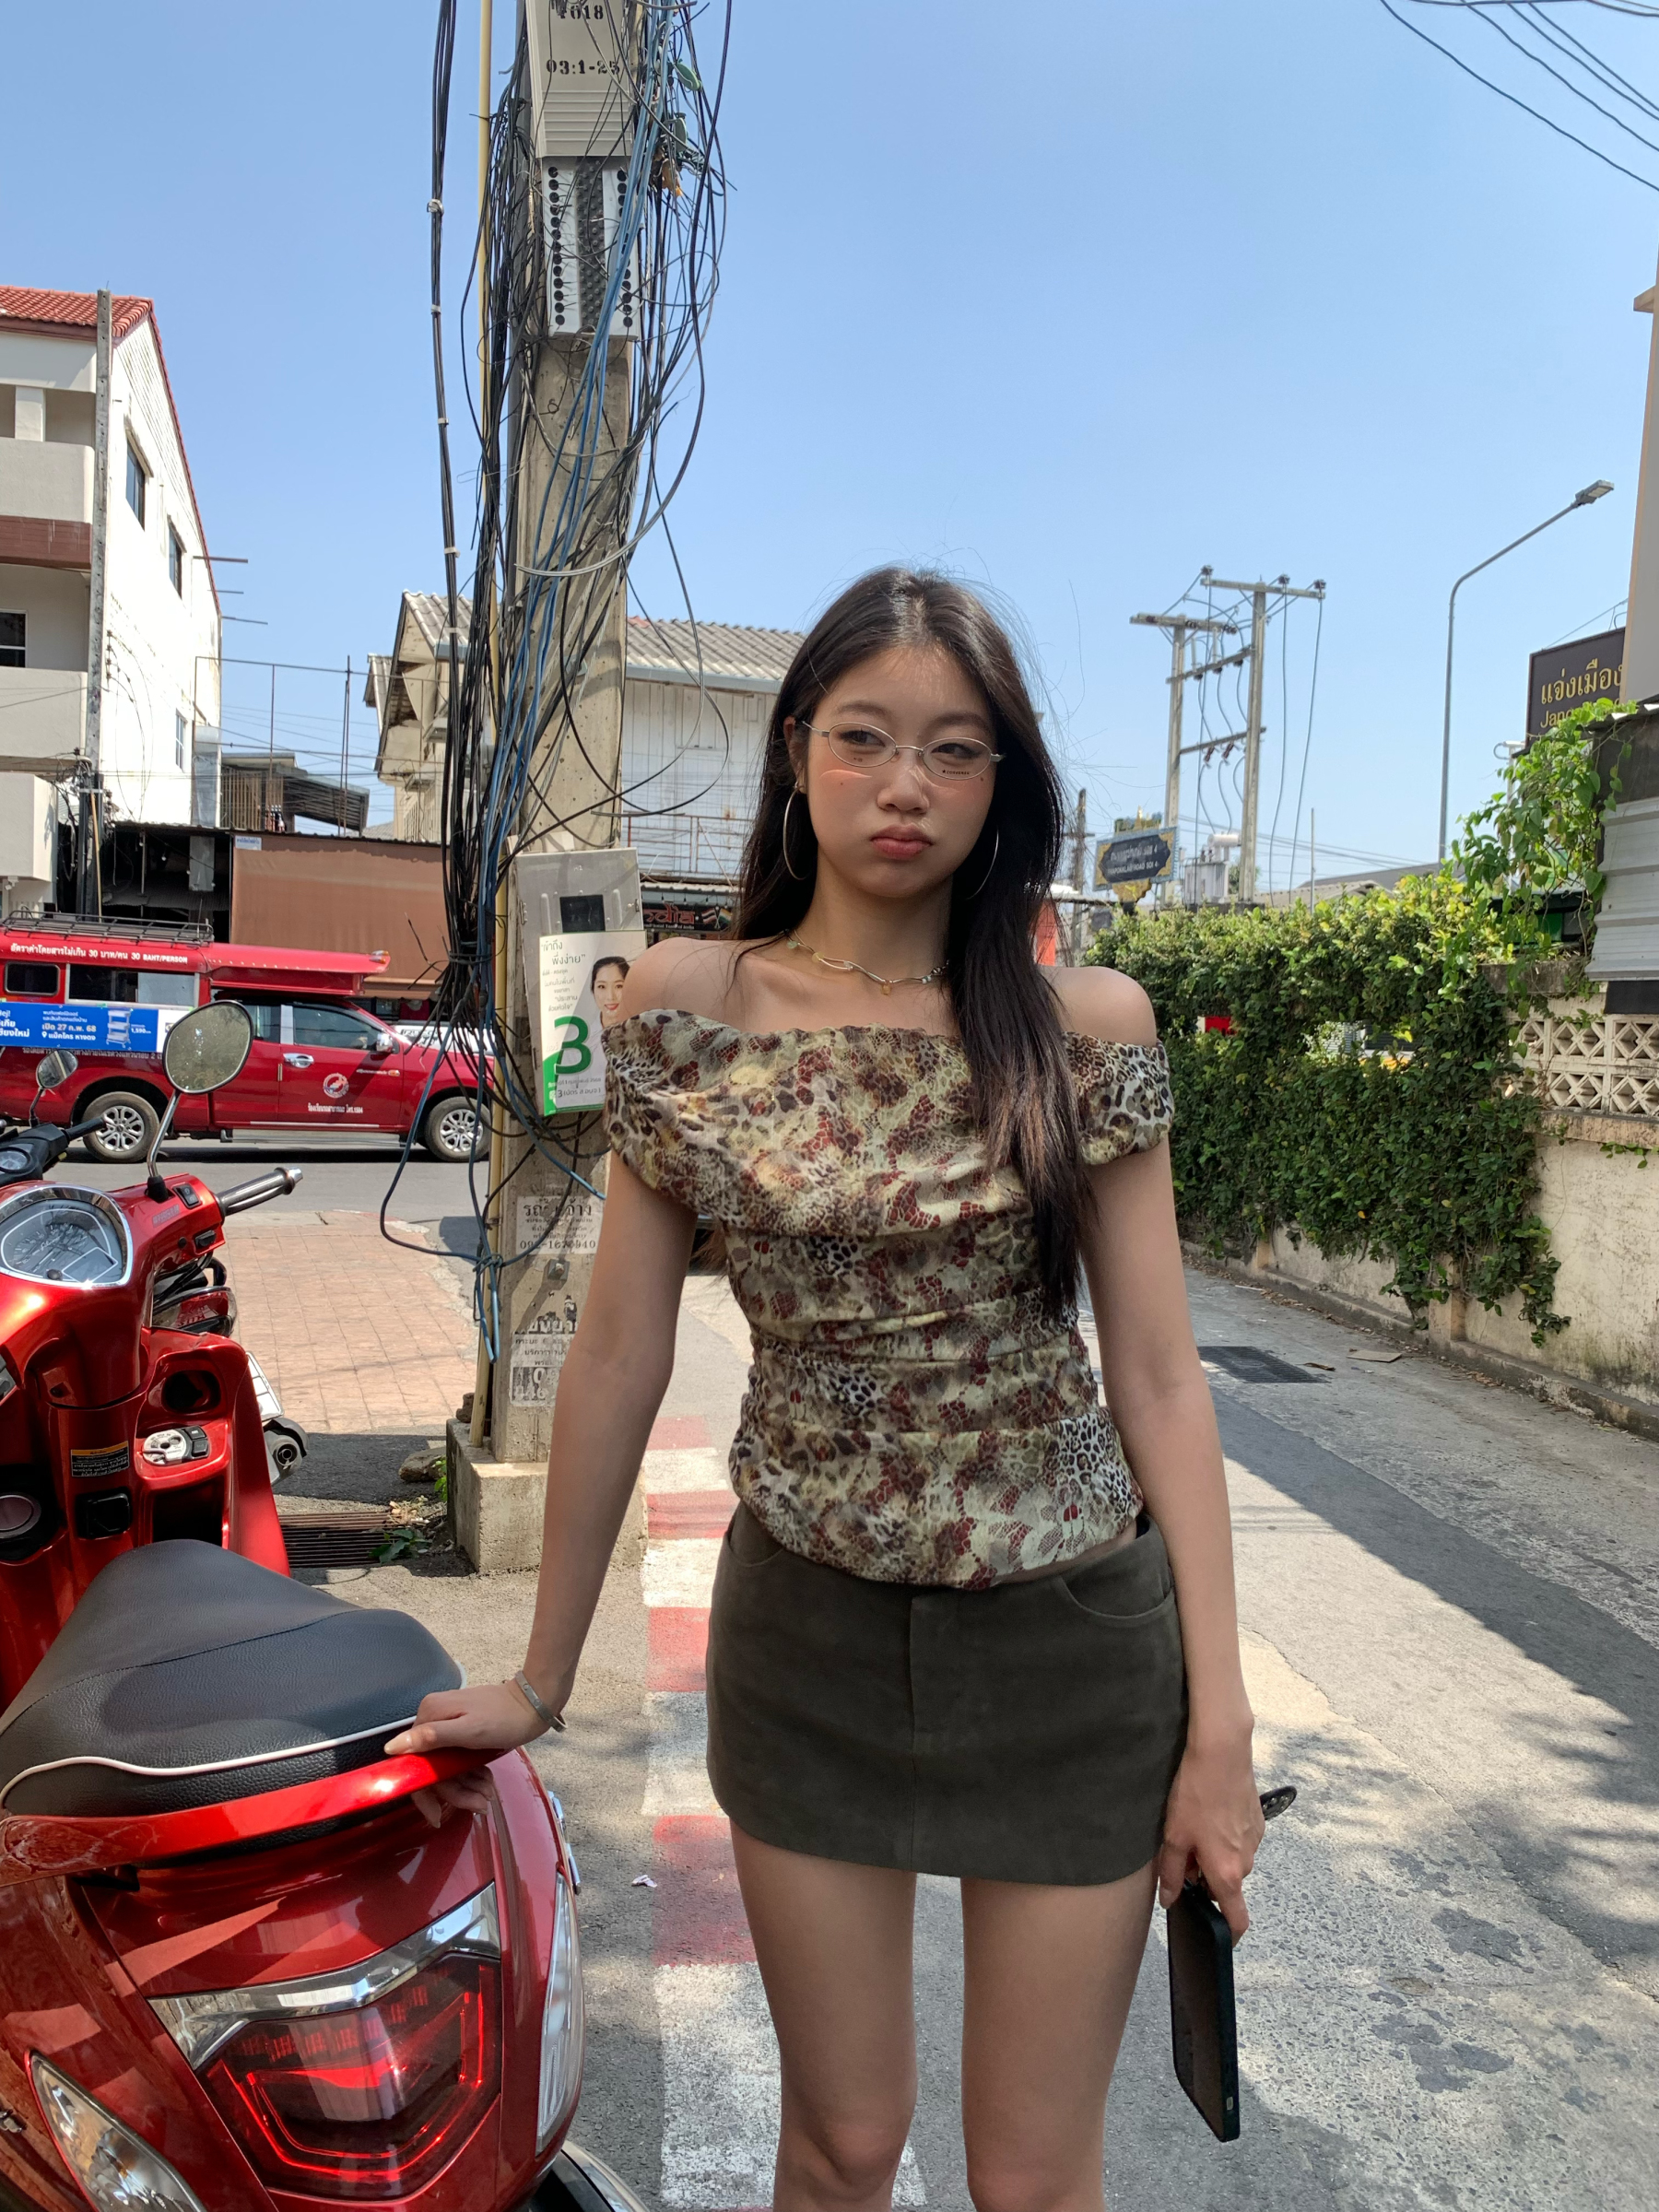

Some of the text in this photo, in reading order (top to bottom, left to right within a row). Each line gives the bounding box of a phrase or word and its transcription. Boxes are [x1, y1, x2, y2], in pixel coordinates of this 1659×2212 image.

[546, 59, 620, 75] 03:1-25
[88, 949, 99, 959] 30
[100, 950, 128, 960] บาท/คน
[131, 952, 141, 961] 30
[143, 953, 188, 965] BAHT/PERSON
[0, 1018, 16, 1028] เกีย
[41, 1022, 55, 1031] เปิด
[57, 1023, 67, 1031] 27
[86, 1025, 97, 1033] 68
[554, 1016, 593, 1076] 3
